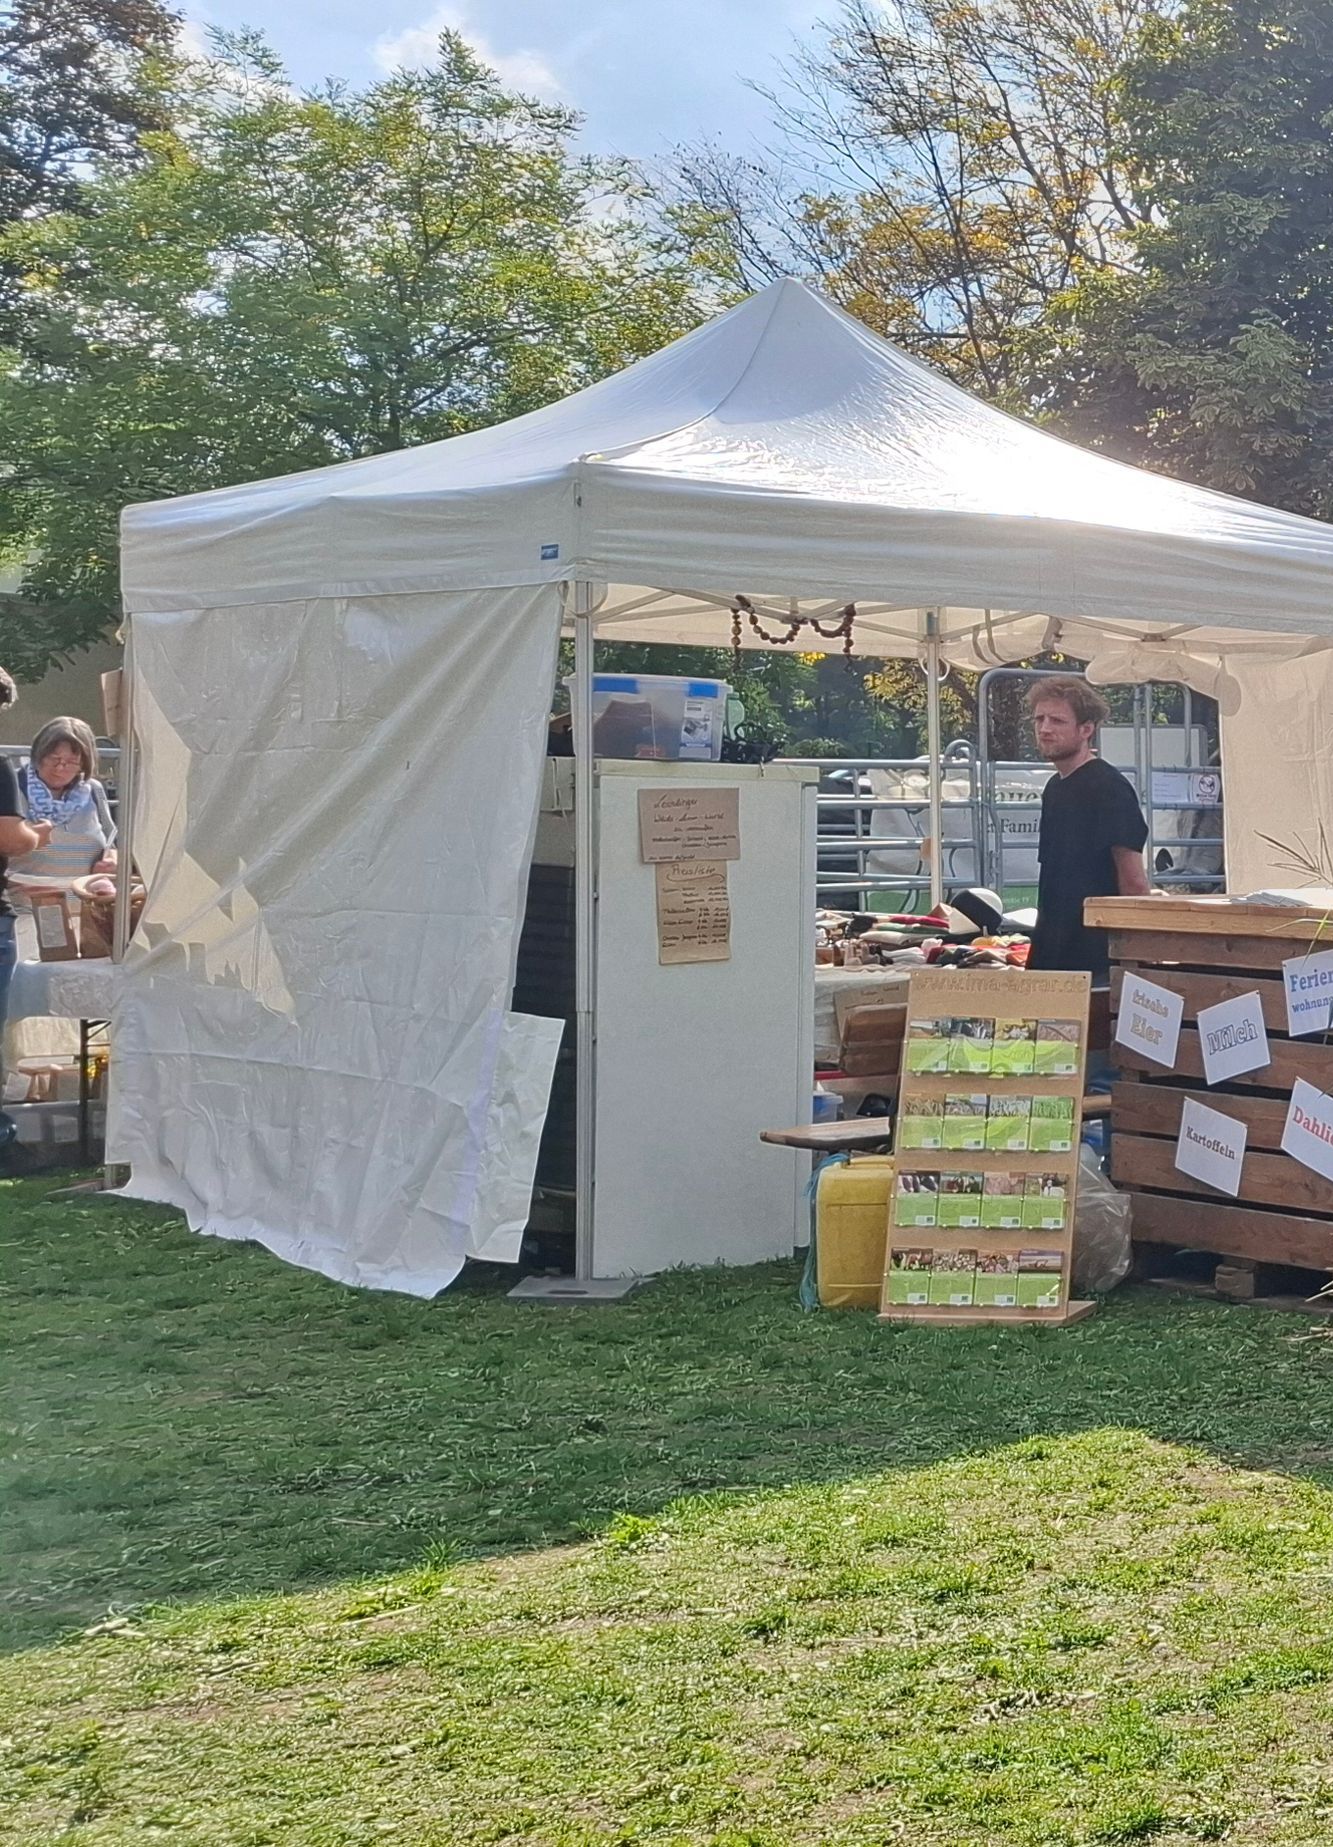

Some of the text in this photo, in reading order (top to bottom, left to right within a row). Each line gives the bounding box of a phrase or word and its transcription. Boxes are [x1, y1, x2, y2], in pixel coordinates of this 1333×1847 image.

[1000, 818, 1040, 833] Fami
[1129, 1012, 1164, 1046] Eier
[1206, 1018, 1258, 1056] Milch
[1186, 1125, 1236, 1161] Kartoffeln
